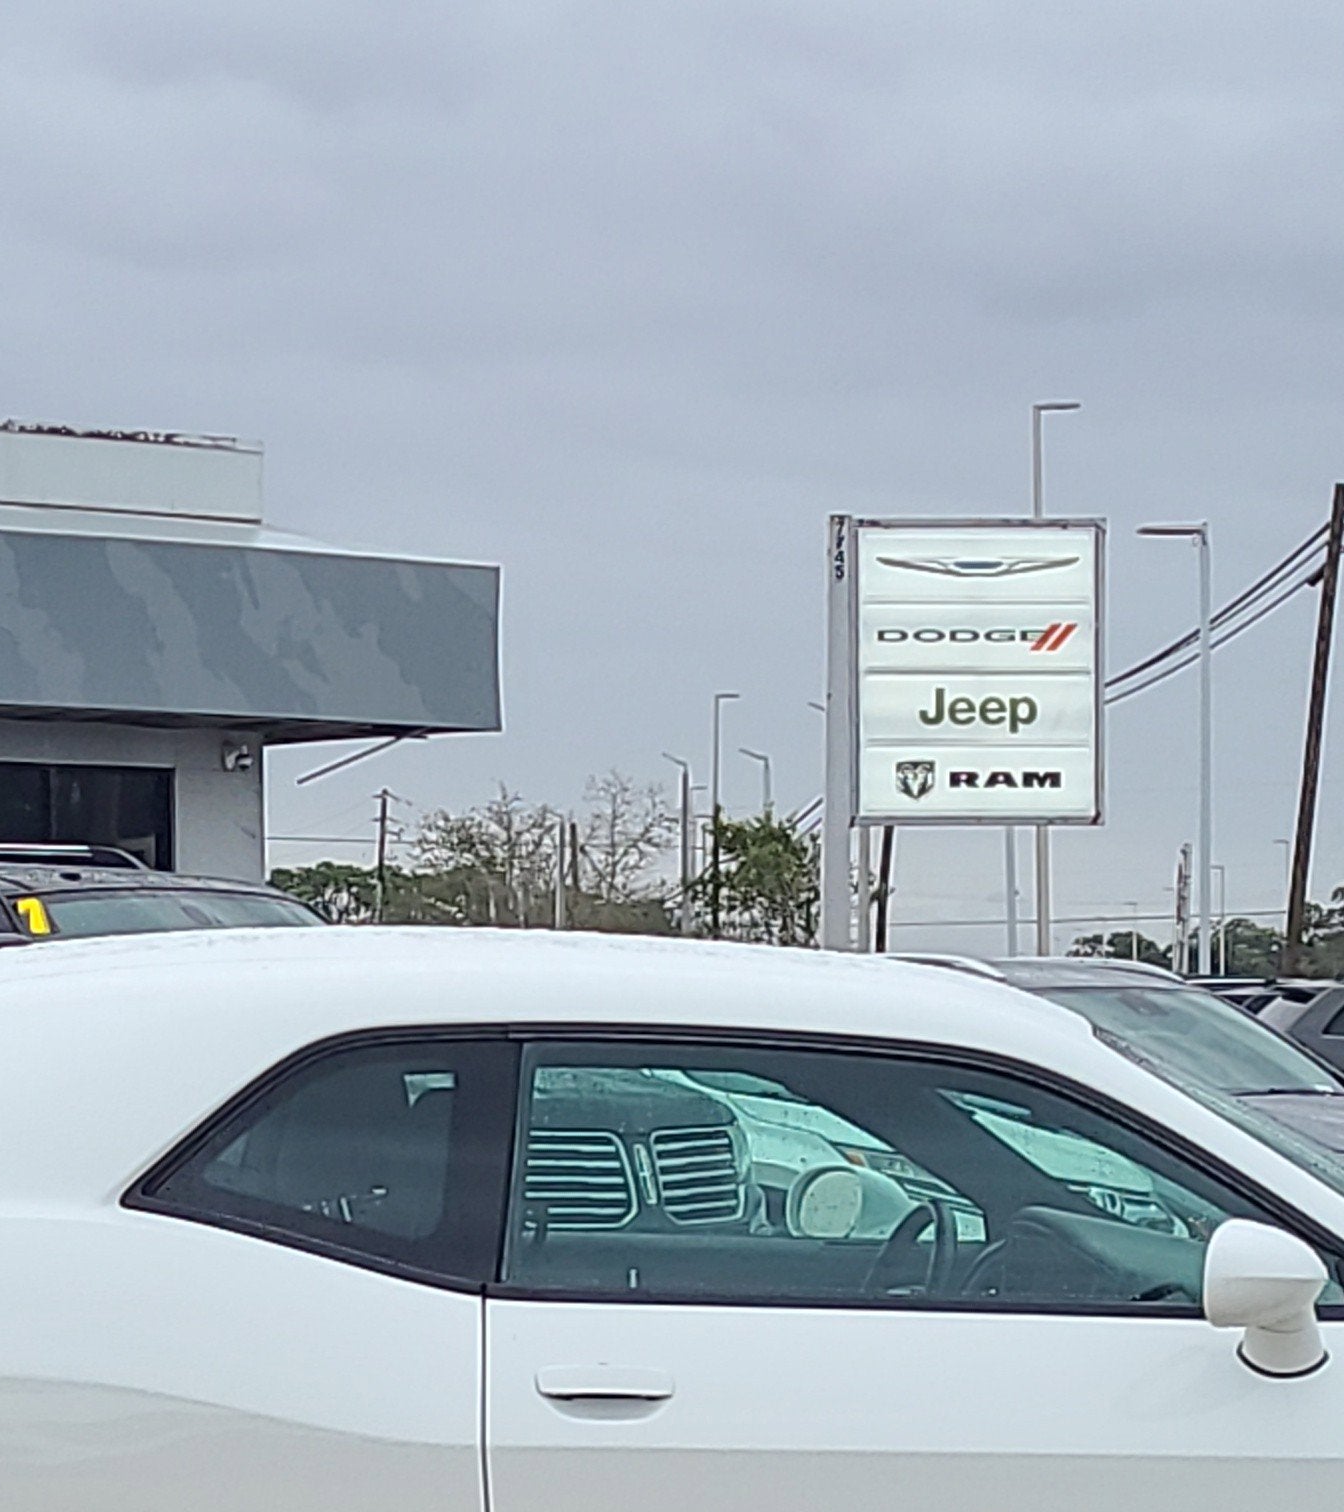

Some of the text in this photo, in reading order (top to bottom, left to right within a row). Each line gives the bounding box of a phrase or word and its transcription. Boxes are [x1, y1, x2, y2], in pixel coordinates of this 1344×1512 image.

[877, 628, 1052, 643] DODGE
[918, 687, 1038, 734] Jeep
[949, 771, 1062, 788] RAM
